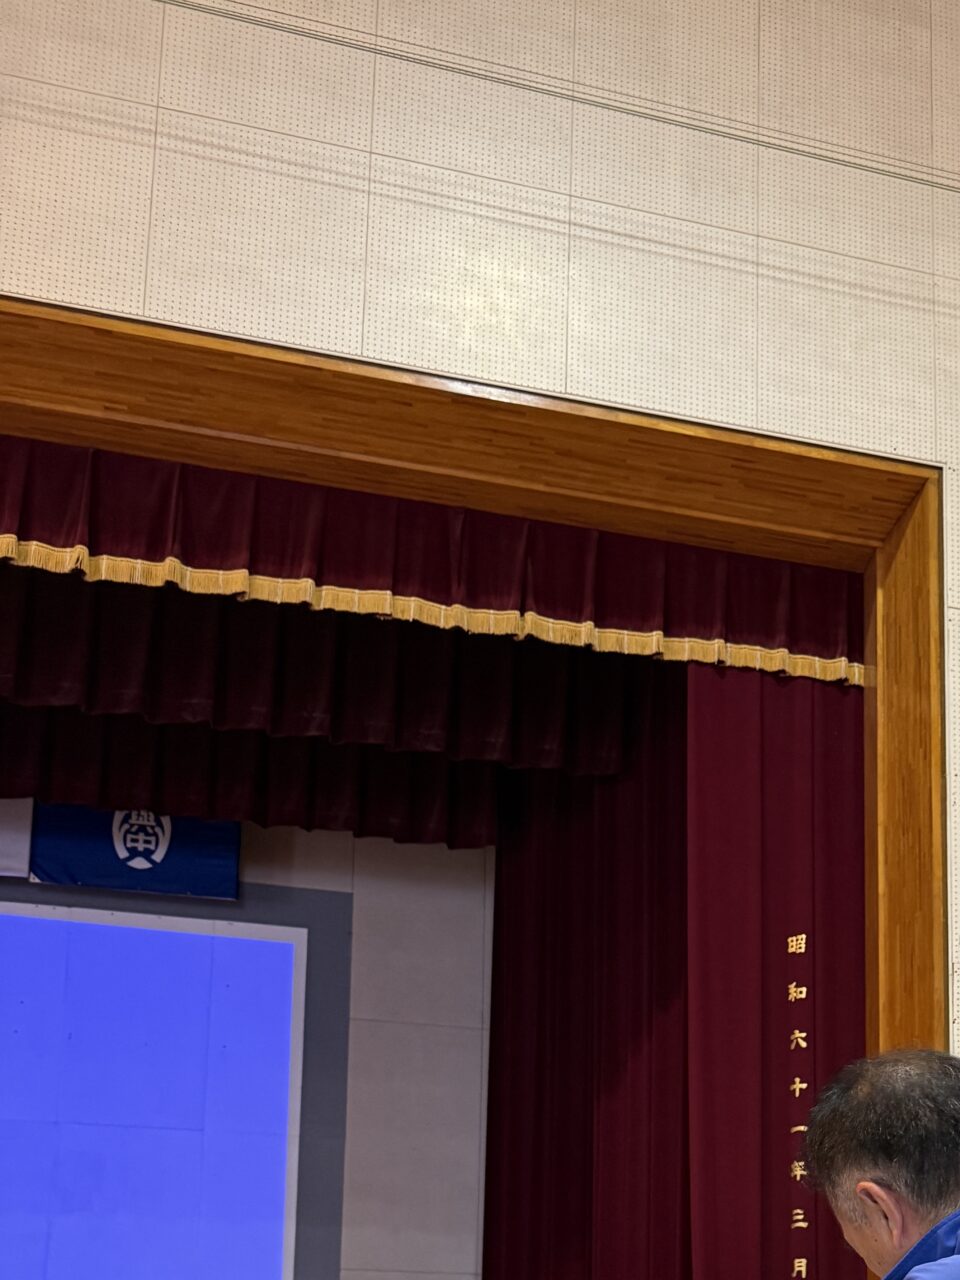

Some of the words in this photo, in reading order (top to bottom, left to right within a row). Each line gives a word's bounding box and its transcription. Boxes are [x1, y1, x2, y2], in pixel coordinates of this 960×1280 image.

[787, 933, 808, 1279] 昭和六十一年三月
